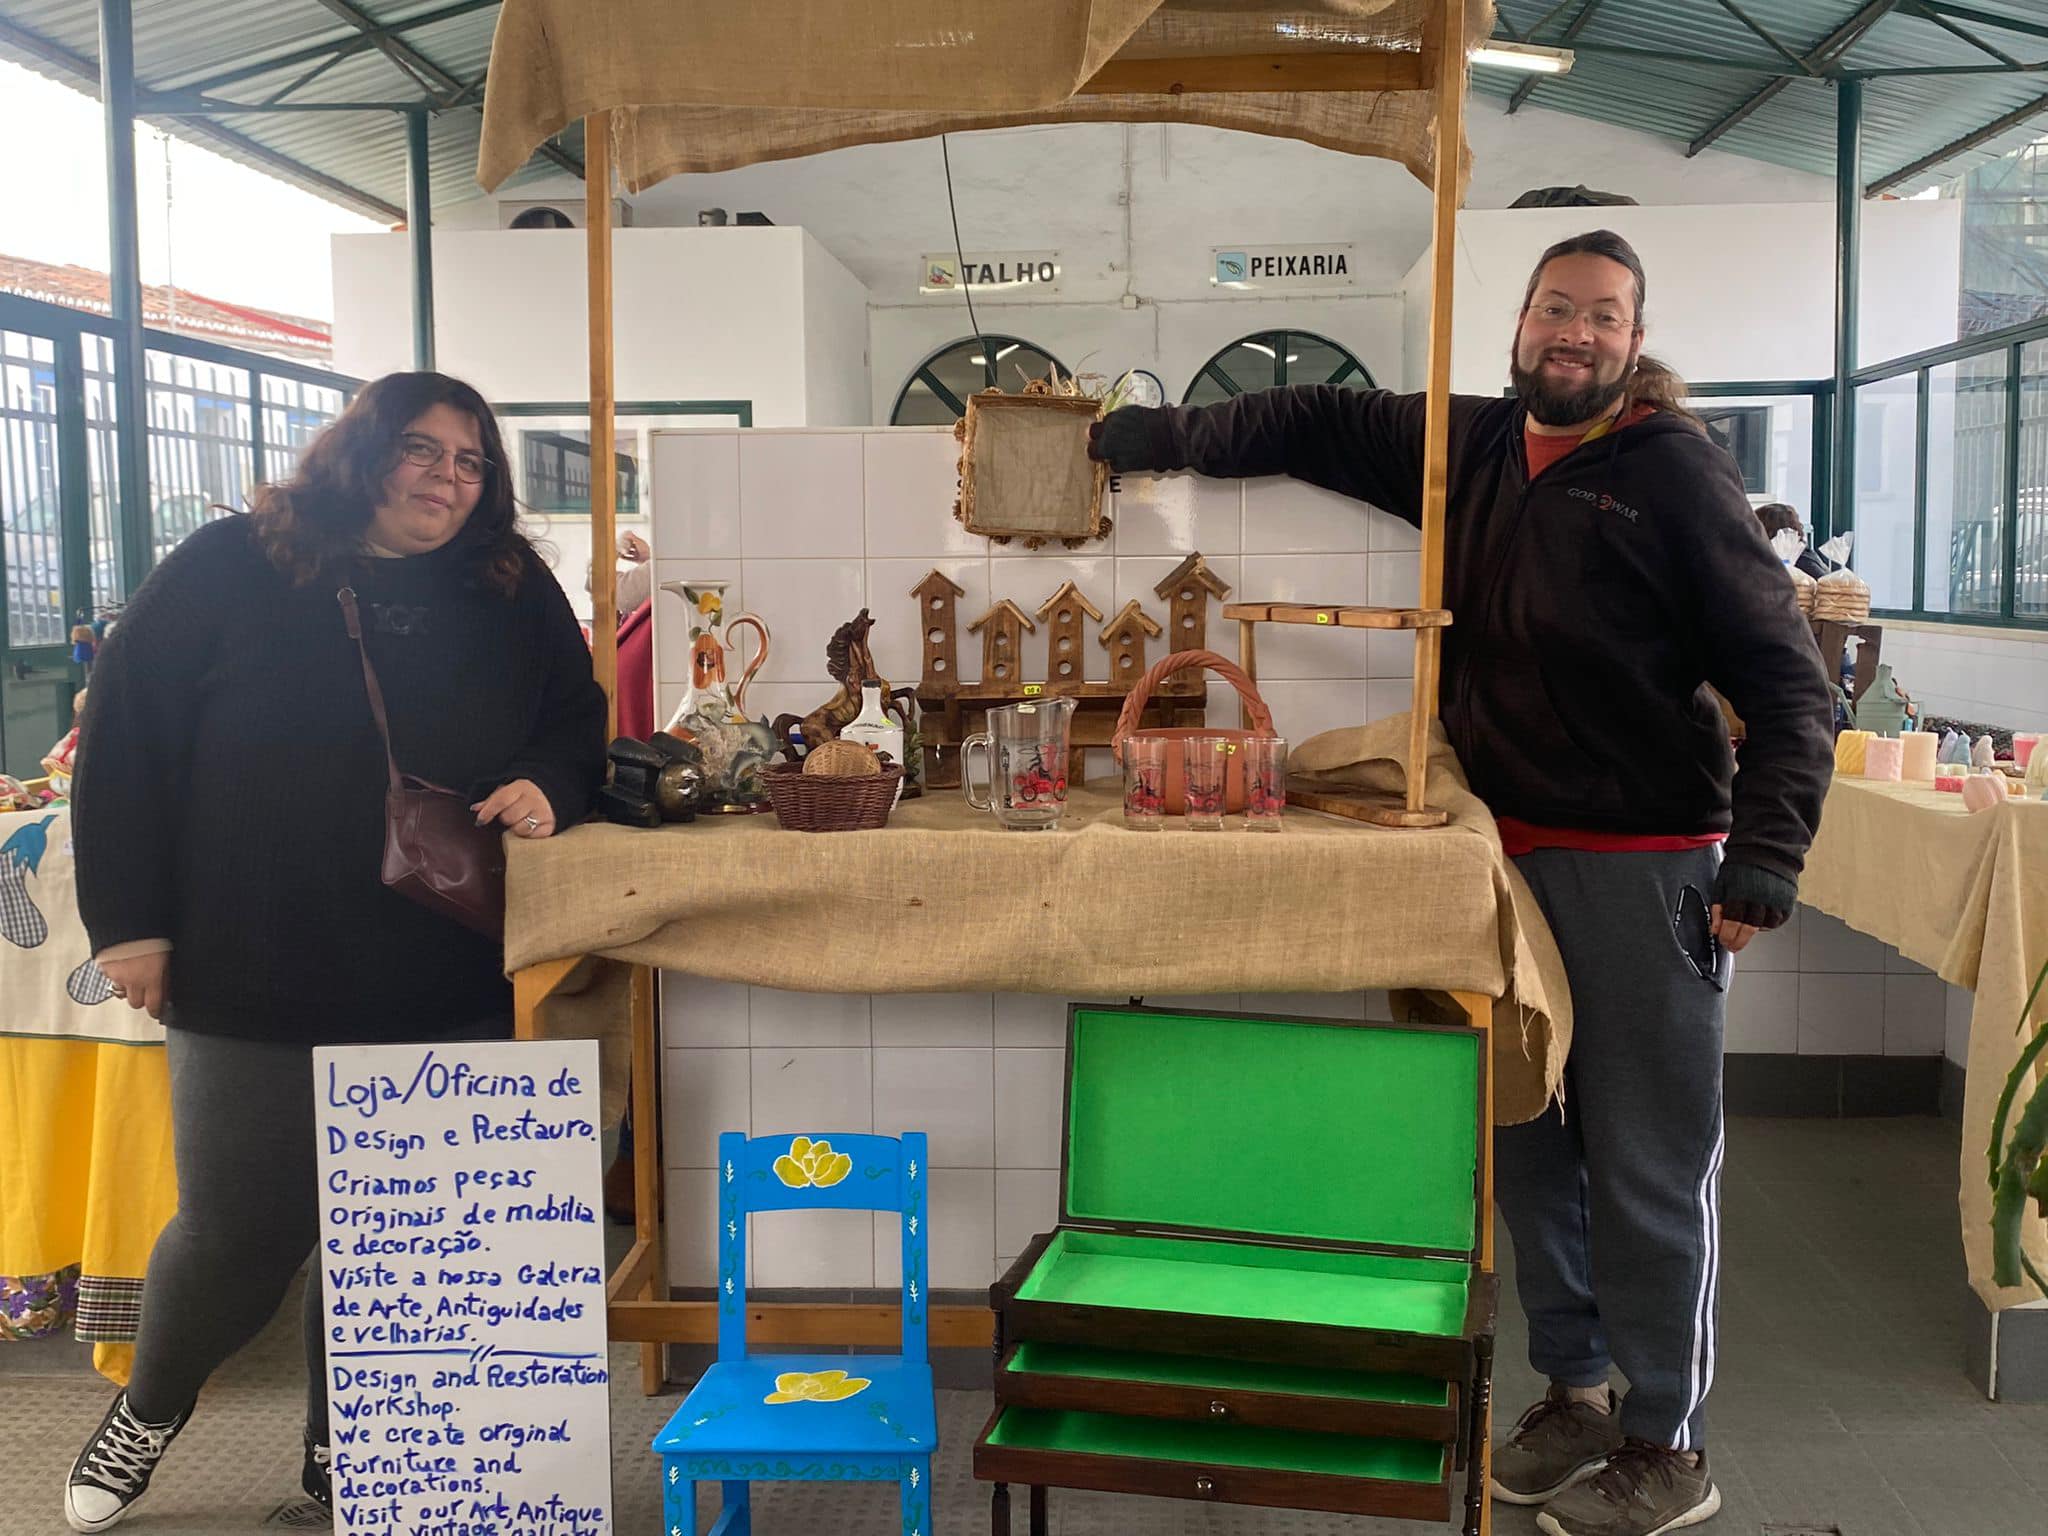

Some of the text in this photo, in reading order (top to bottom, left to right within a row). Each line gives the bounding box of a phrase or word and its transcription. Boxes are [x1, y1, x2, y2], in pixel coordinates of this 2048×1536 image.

[963, 261, 1055, 283] TALHO
[1250, 254, 1348, 278] PEIXARIA
[1567, 487, 1597, 502] GOD
[1610, 500, 1639, 523] WAR
[549, 1068, 580, 1096] de
[327, 1110, 595, 1159] Design e Restauro.
[329, 1170, 536, 1198] Criamos peças
[463, 1203, 496, 1225] de
[327, 1229, 489, 1259] e decoração.
[330, 1262, 397, 1289] Visite
[412, 1272, 426, 1286] a
[439, 1270, 501, 1286] nossa
[333, 1296, 360, 1316] de
[437, 1292, 584, 1326] Antiguidades
[332, 1327, 345, 1342] e
[333, 1359, 608, 1391] Design and Restoration
[386, 1423, 464, 1446] create
[480, 1420, 570, 1448] original
[334, 1448, 521, 1478] furniture and
[339, 1473, 490, 1499] decorations.
[341, 1499, 402, 1526] Visit
[420, 1500, 463, 1522] our
[516, 1494, 604, 1534] Antique
